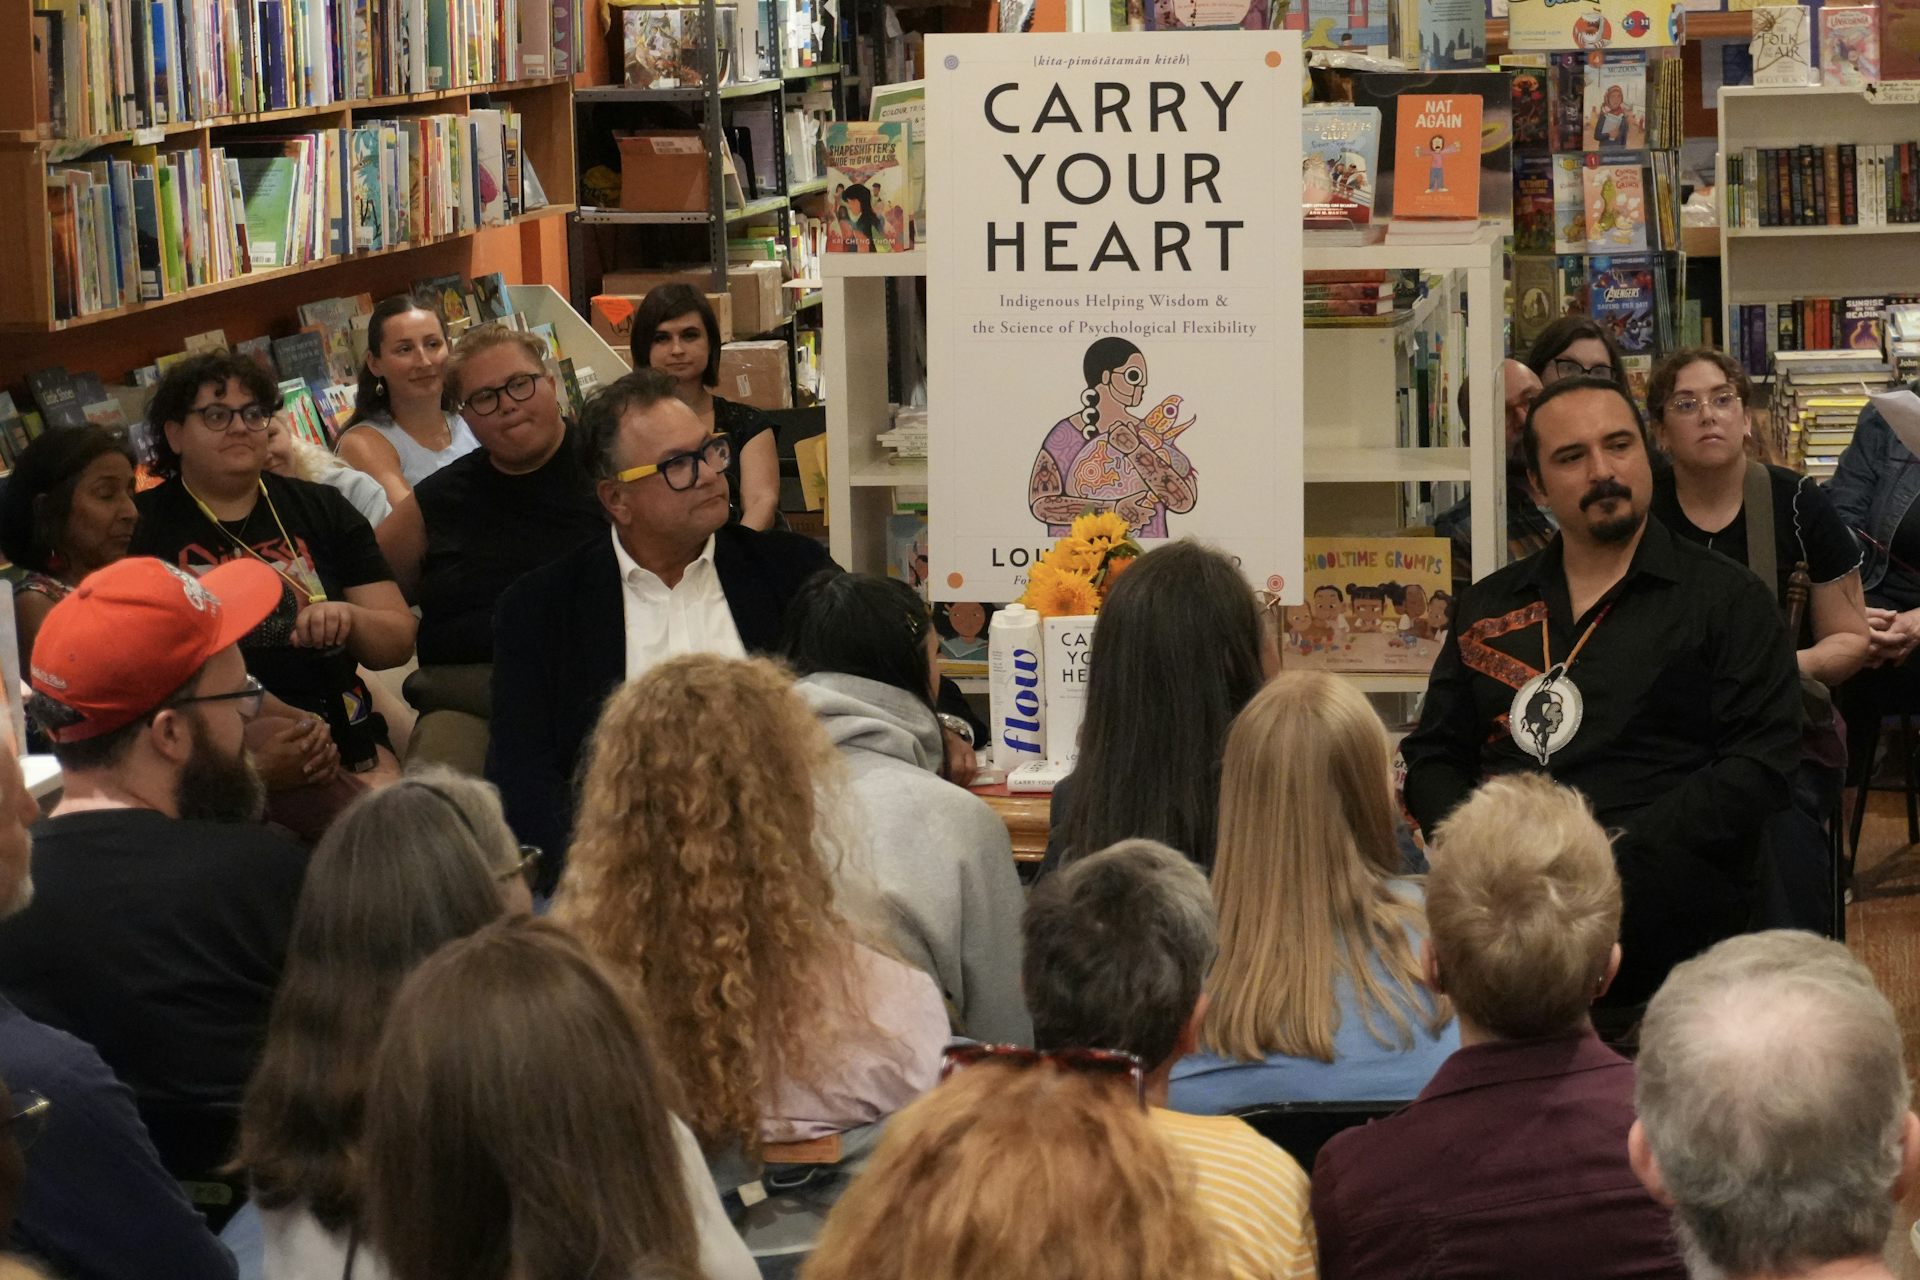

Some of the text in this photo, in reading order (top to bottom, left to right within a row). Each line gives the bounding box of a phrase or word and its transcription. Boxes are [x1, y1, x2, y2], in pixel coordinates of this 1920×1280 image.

[984, 81, 1244, 133] CARRY
[1425, 99, 1453, 113] NAT
[1415, 113, 1462, 128] AGAIN
[829, 143, 896, 156] SHAPESHIFTER'S
[1003, 152, 1222, 205] YOUR
[987, 221, 1244, 272] HEART
[1000, 294, 1229, 311] Indigenous Helping Wisdom &
[1604, 286, 1640, 302] AVENGERS
[1846, 299, 1884, 307] SUNRISE
[972, 319, 1257, 338] the Science of Psychological Flexibility
[1385, 551, 1442, 574] GRUMPS
[1003, 649, 1041, 754] flow
